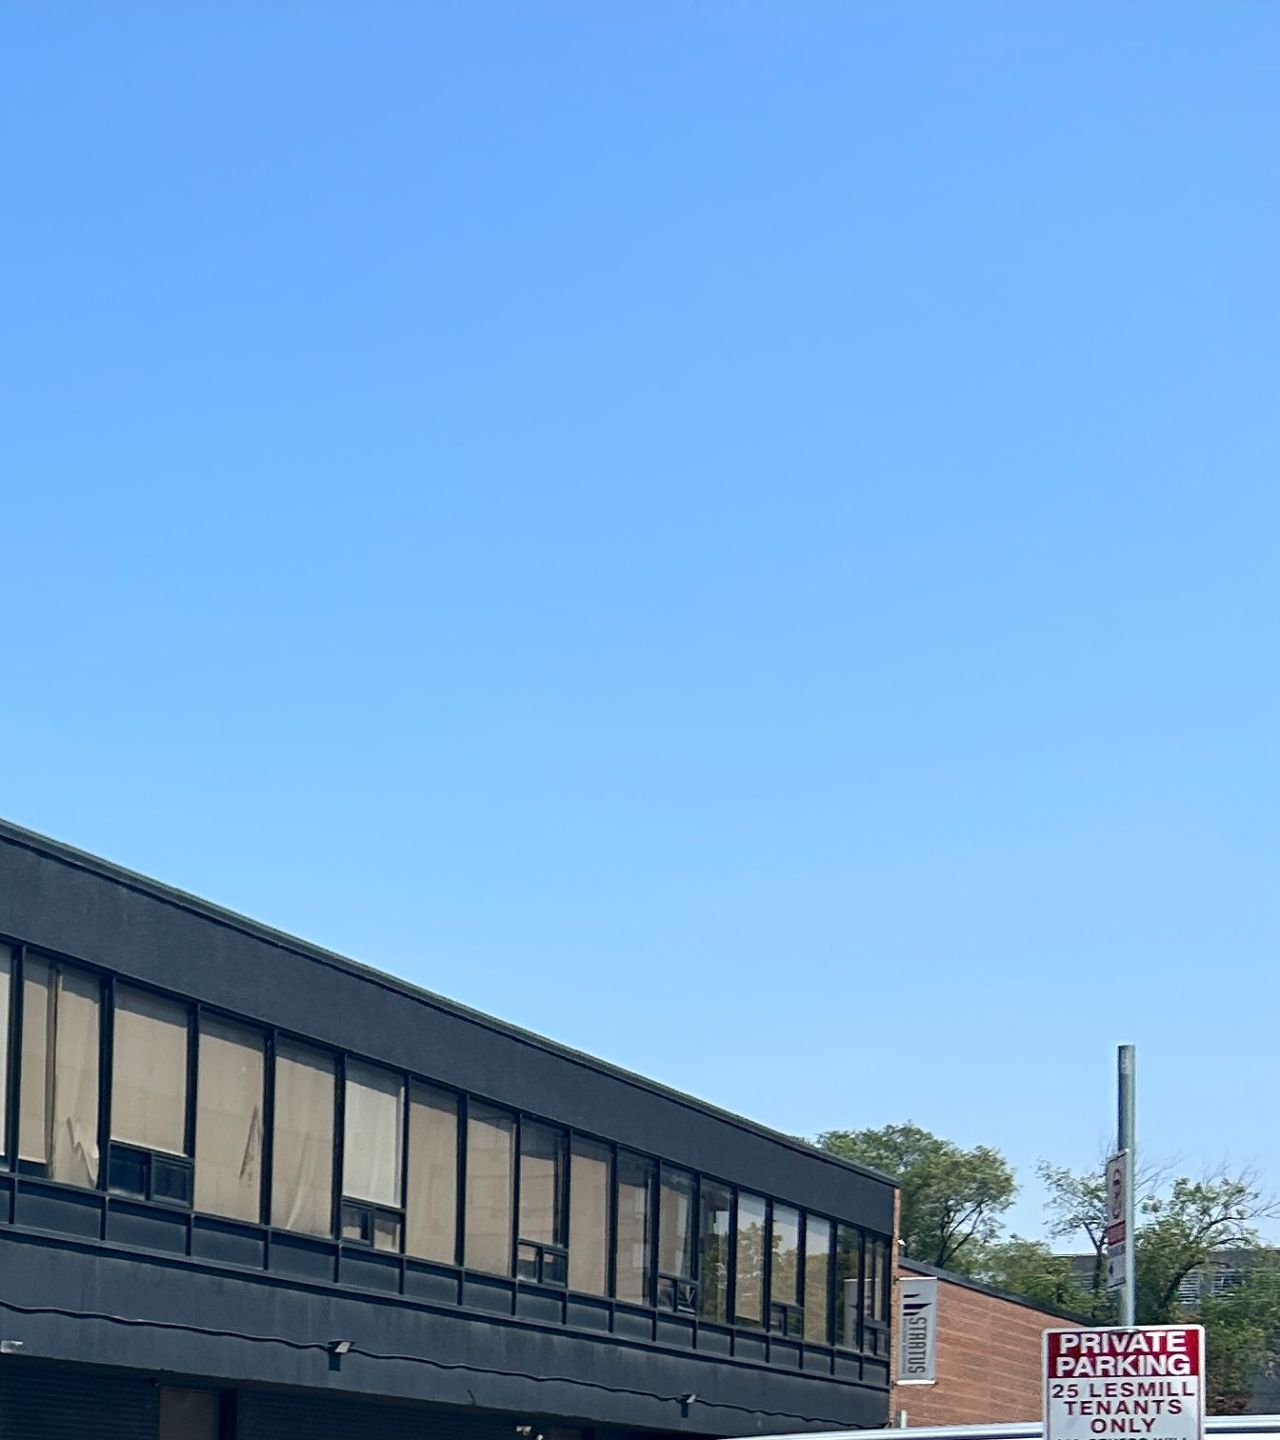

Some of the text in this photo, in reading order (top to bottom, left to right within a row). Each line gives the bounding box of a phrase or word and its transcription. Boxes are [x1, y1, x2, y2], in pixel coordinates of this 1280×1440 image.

[907, 1317, 928, 1374] STRATUS
[1059, 1331, 1187, 1353] PRIVATE
[1056, 1353, 1191, 1377] PARKING
[1052, 1381, 1195, 1398] 25 LESMILL
[1063, 1399, 1182, 1416] TENANTS
[1091, 1418, 1156, 1433] ONLY
